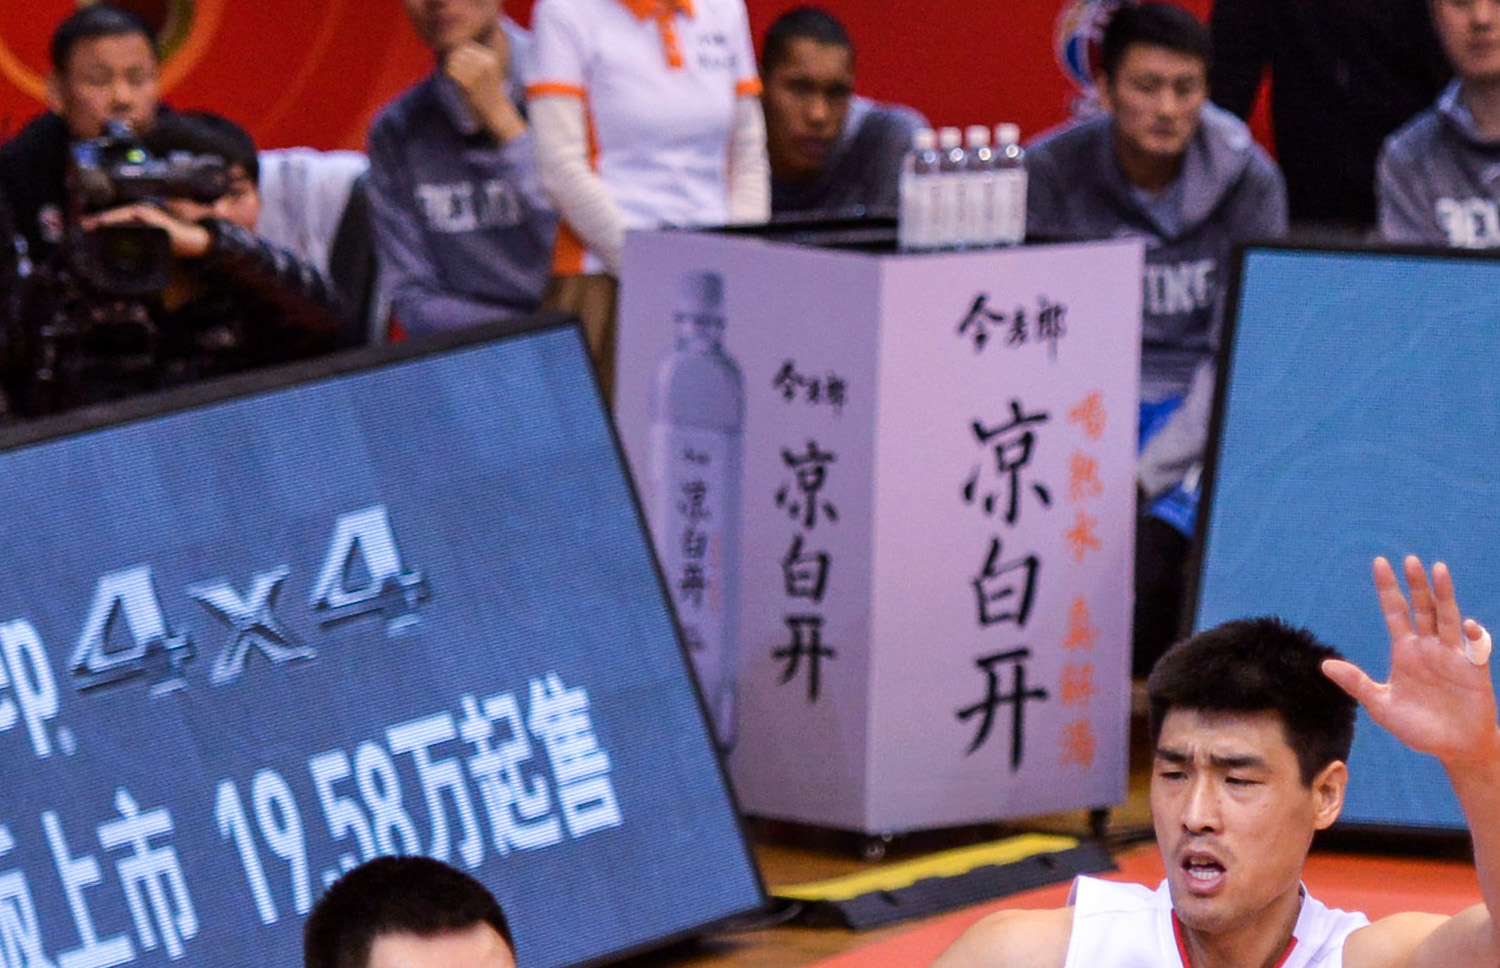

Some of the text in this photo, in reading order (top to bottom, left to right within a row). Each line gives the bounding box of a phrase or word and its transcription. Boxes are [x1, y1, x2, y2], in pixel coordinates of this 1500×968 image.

[769, 438, 841, 702] 凉白开
[955, 398, 1054, 774] 凉白开
